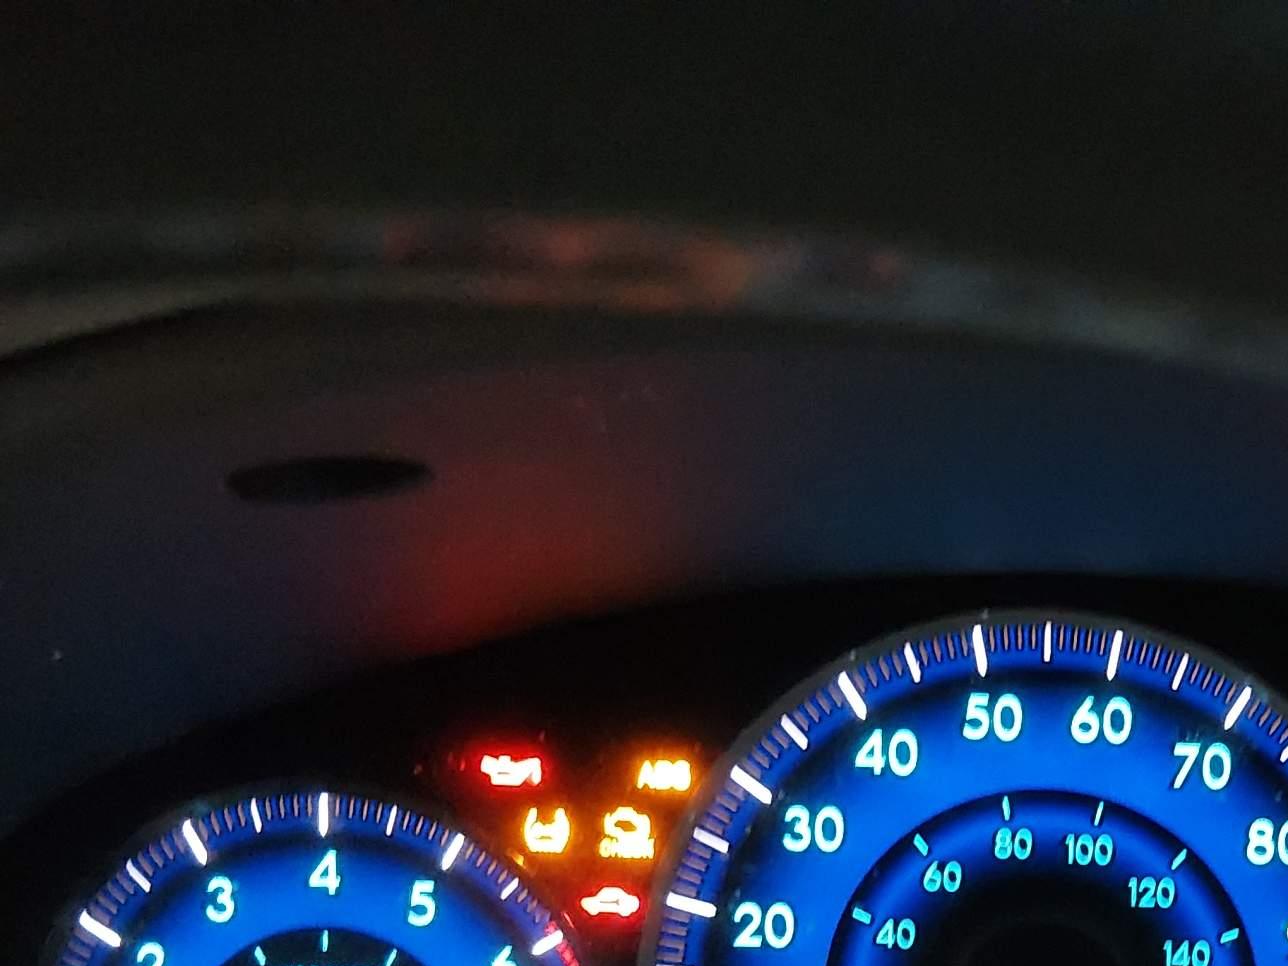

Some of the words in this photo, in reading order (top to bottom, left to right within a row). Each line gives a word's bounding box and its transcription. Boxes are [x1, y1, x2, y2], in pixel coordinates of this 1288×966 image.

[962, 692, 1023, 742] 50
[1070, 695, 1133, 745] 60
[854, 728, 919, 777] 40
[1173, 741, 1232, 791] 70
[782, 804, 845, 853] 30
[994, 826, 1033, 860] 80
[1065, 833, 1114, 866] 100
[308, 849, 341, 896] 4
[922, 860, 962, 893] 60
[1127, 876, 1176, 909] 120
[205, 875, 235, 924] 3
[407, 879, 436, 927] 5
[733, 901, 795, 949] 20
[875, 918, 916, 950] 40
